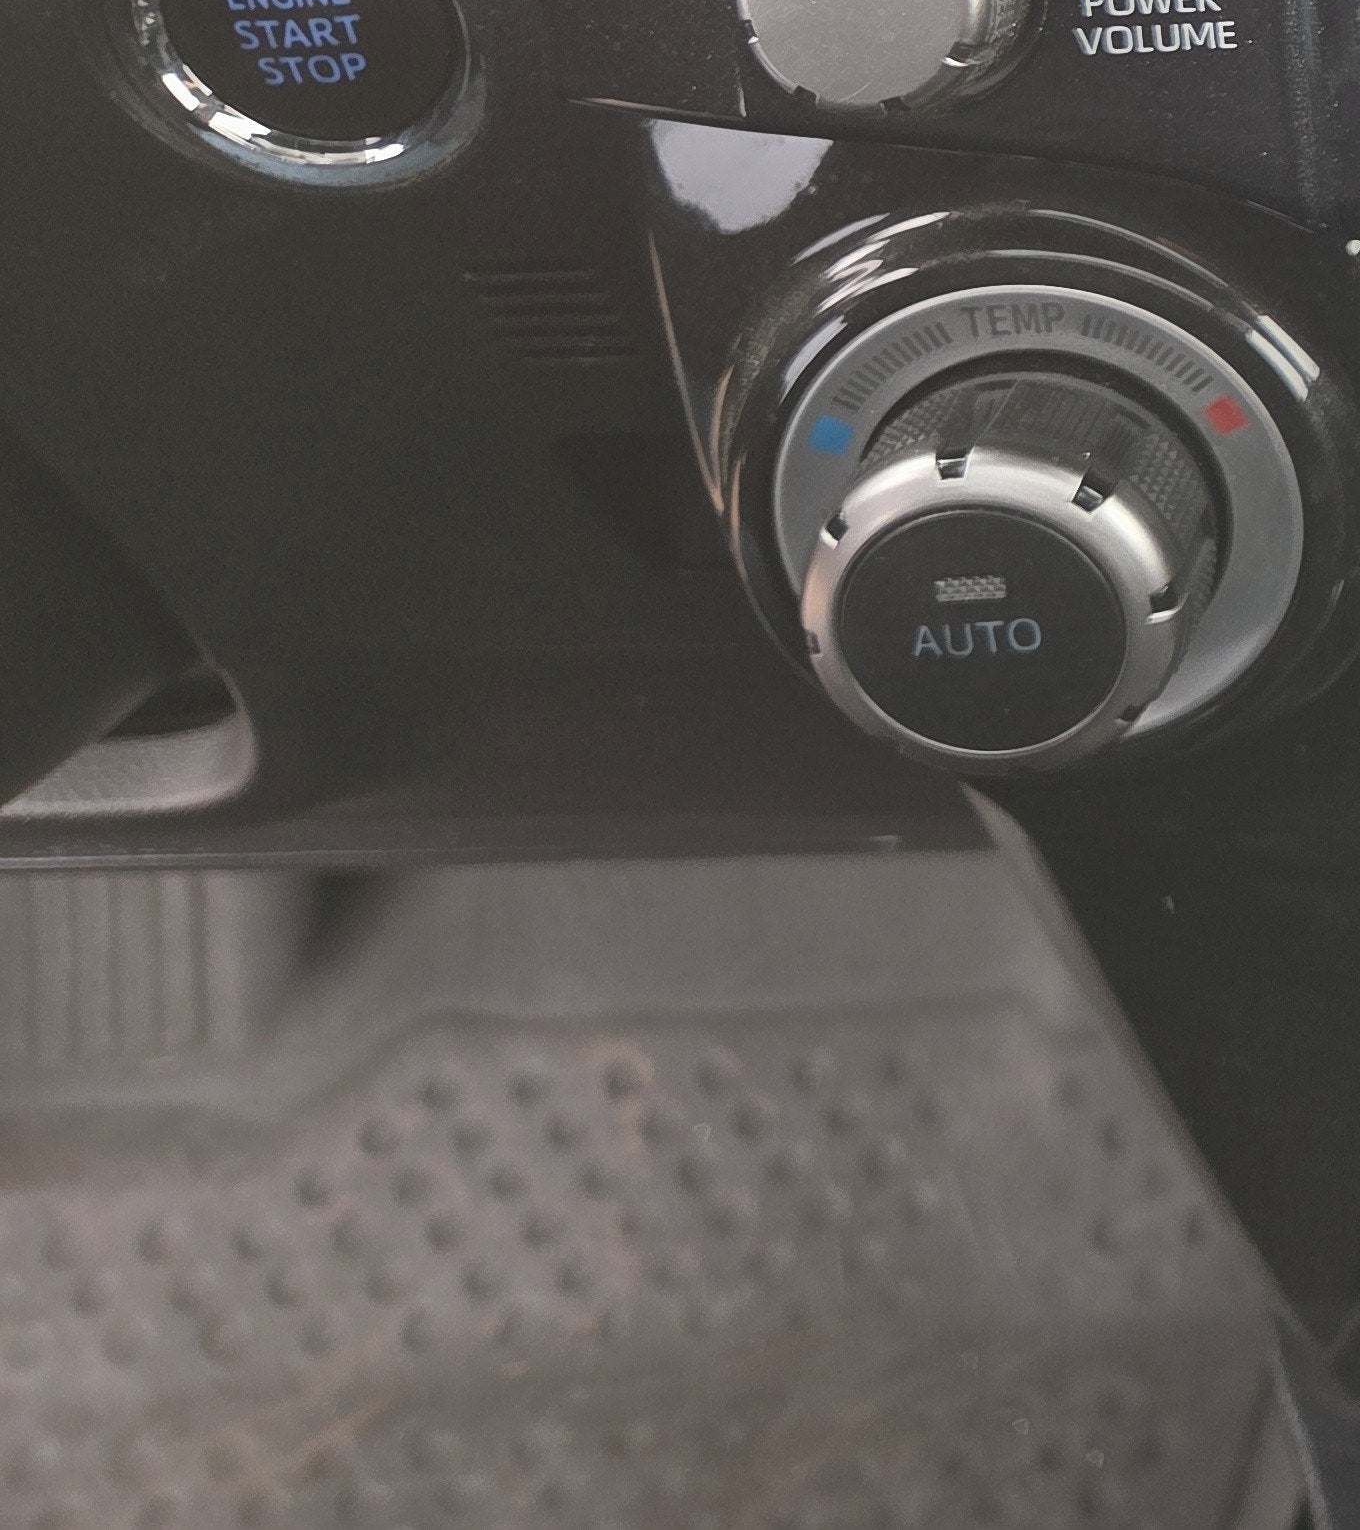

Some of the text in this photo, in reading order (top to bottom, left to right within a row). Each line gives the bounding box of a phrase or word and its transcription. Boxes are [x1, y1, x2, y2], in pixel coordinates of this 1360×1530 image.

[233, 13, 360, 50] START
[1072, 20, 1238, 55] VOLUME
[257, 52, 367, 86] STOP
[961, 302, 1065, 340] TEMP
[911, 617, 1042, 659] AUTO
